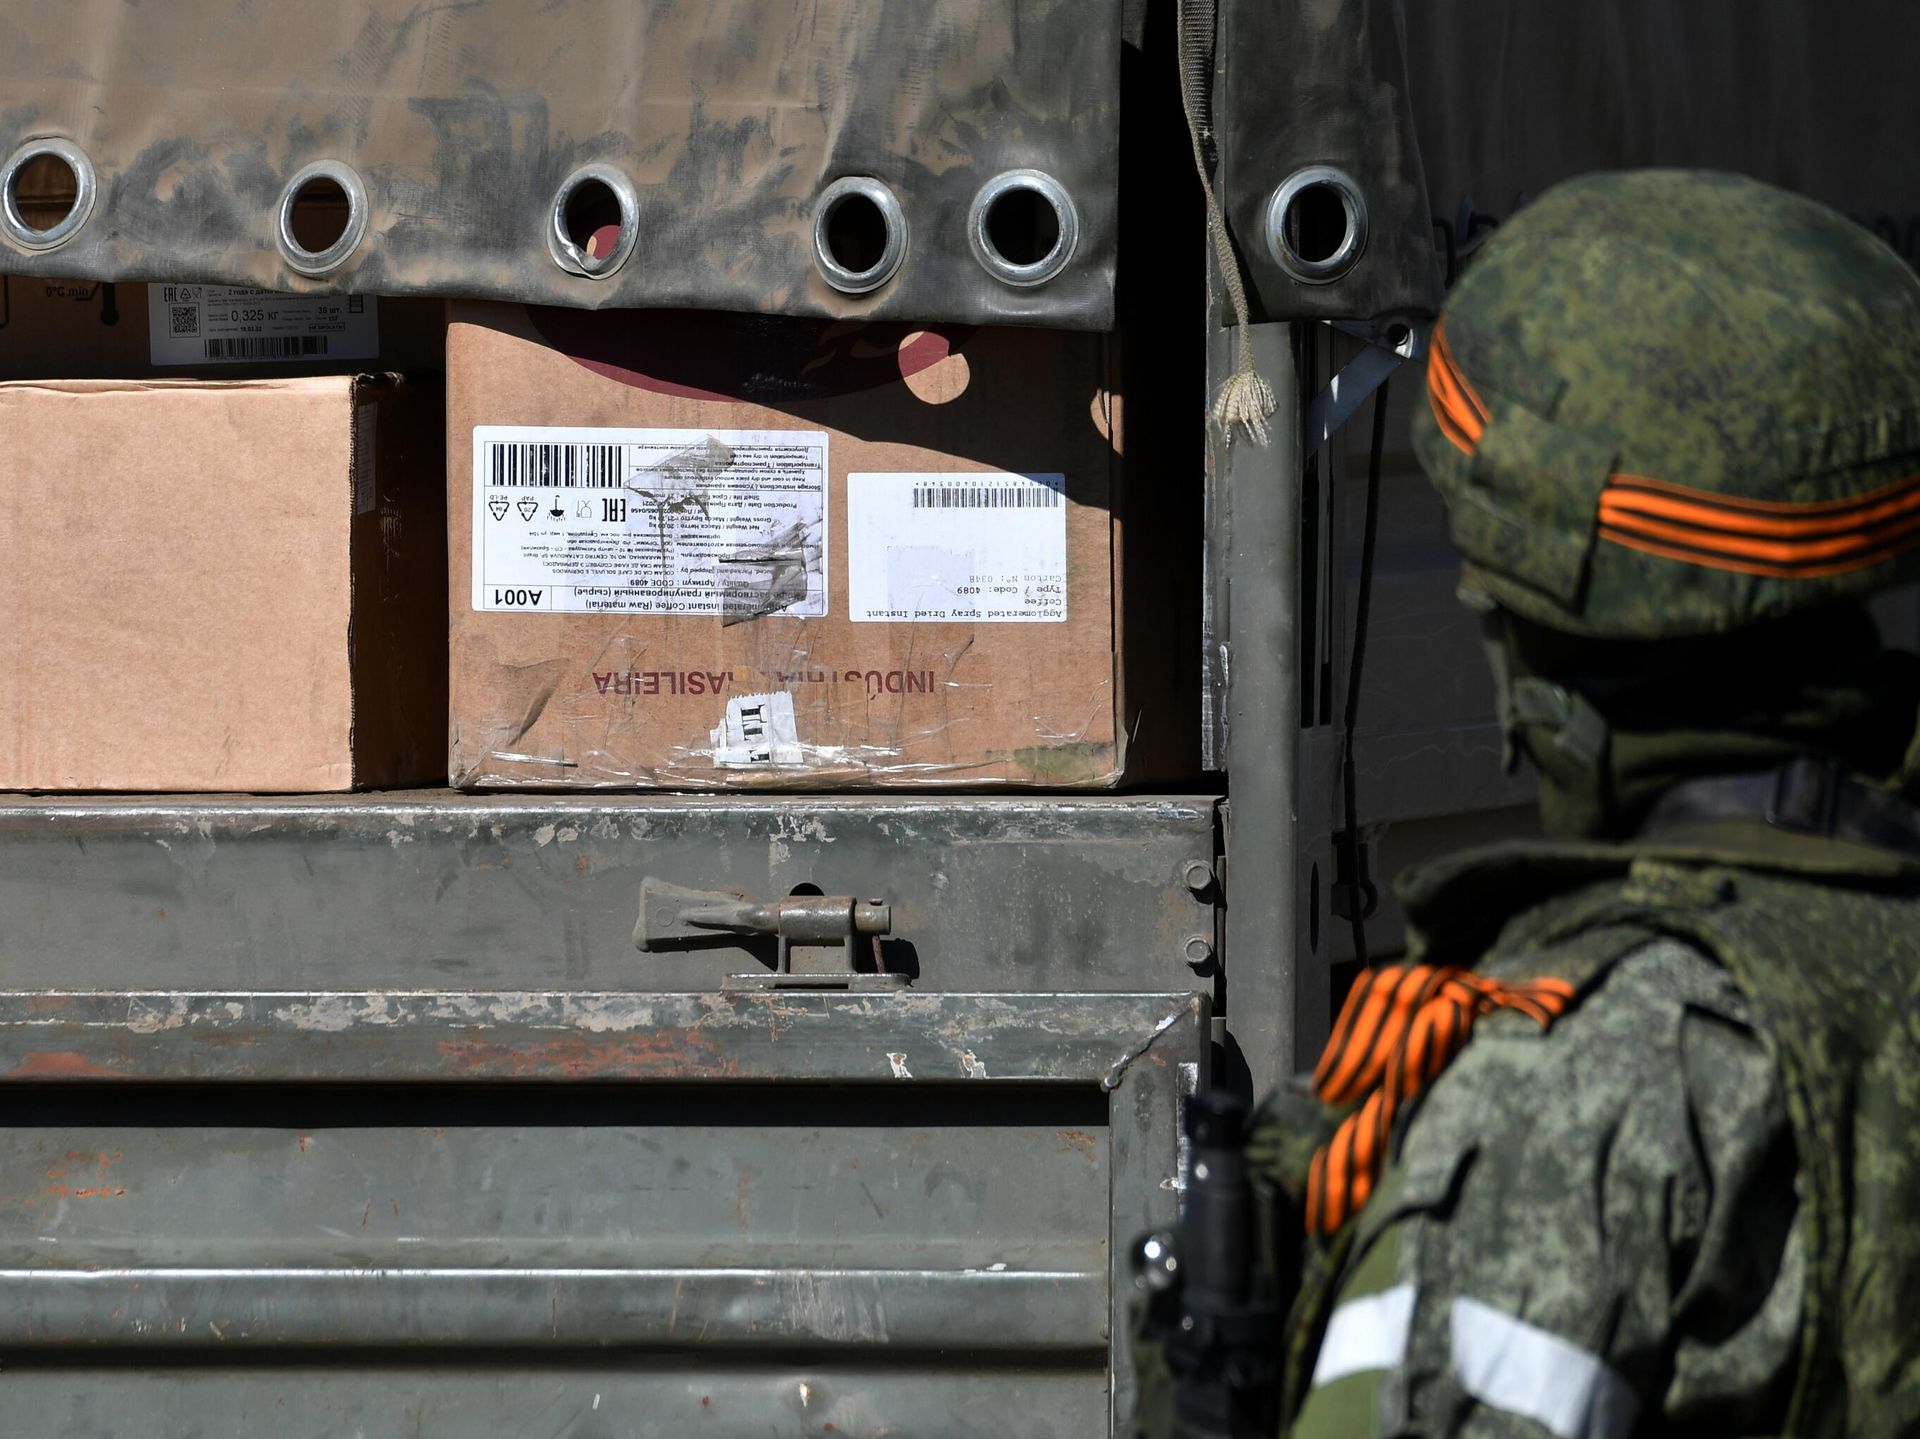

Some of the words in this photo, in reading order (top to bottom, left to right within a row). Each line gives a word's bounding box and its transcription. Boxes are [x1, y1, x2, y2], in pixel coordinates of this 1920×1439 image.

[46, 286, 64, 298] 0°C
[68, 286, 88, 296] min
[231, 310, 264, 322] 0,325
[602, 498, 626, 522] EAC
[969, 574, 993, 582] 0348
[574, 587, 611, 597] (сырье)
[614, 588, 701, 598] гранулированный
[956, 586, 981, 594] 4089
[988, 586, 1018, 594] Code:
[1036, 585, 1062, 594] Type
[495, 590, 542, 606] A001
[586, 600, 626, 610] material)
[628, 600, 652, 610] (Raw
[656, 602, 685, 610] Coffee
[722, 601, 787, 612] Aggmerated
[866, 610, 908, 618] Instant
[914, 610, 946, 618] Dried
[950, 608, 982, 618] Spray
[988, 608, 1062, 618] Agglomerated
[592, 671, 734, 695] ASILEIRA
